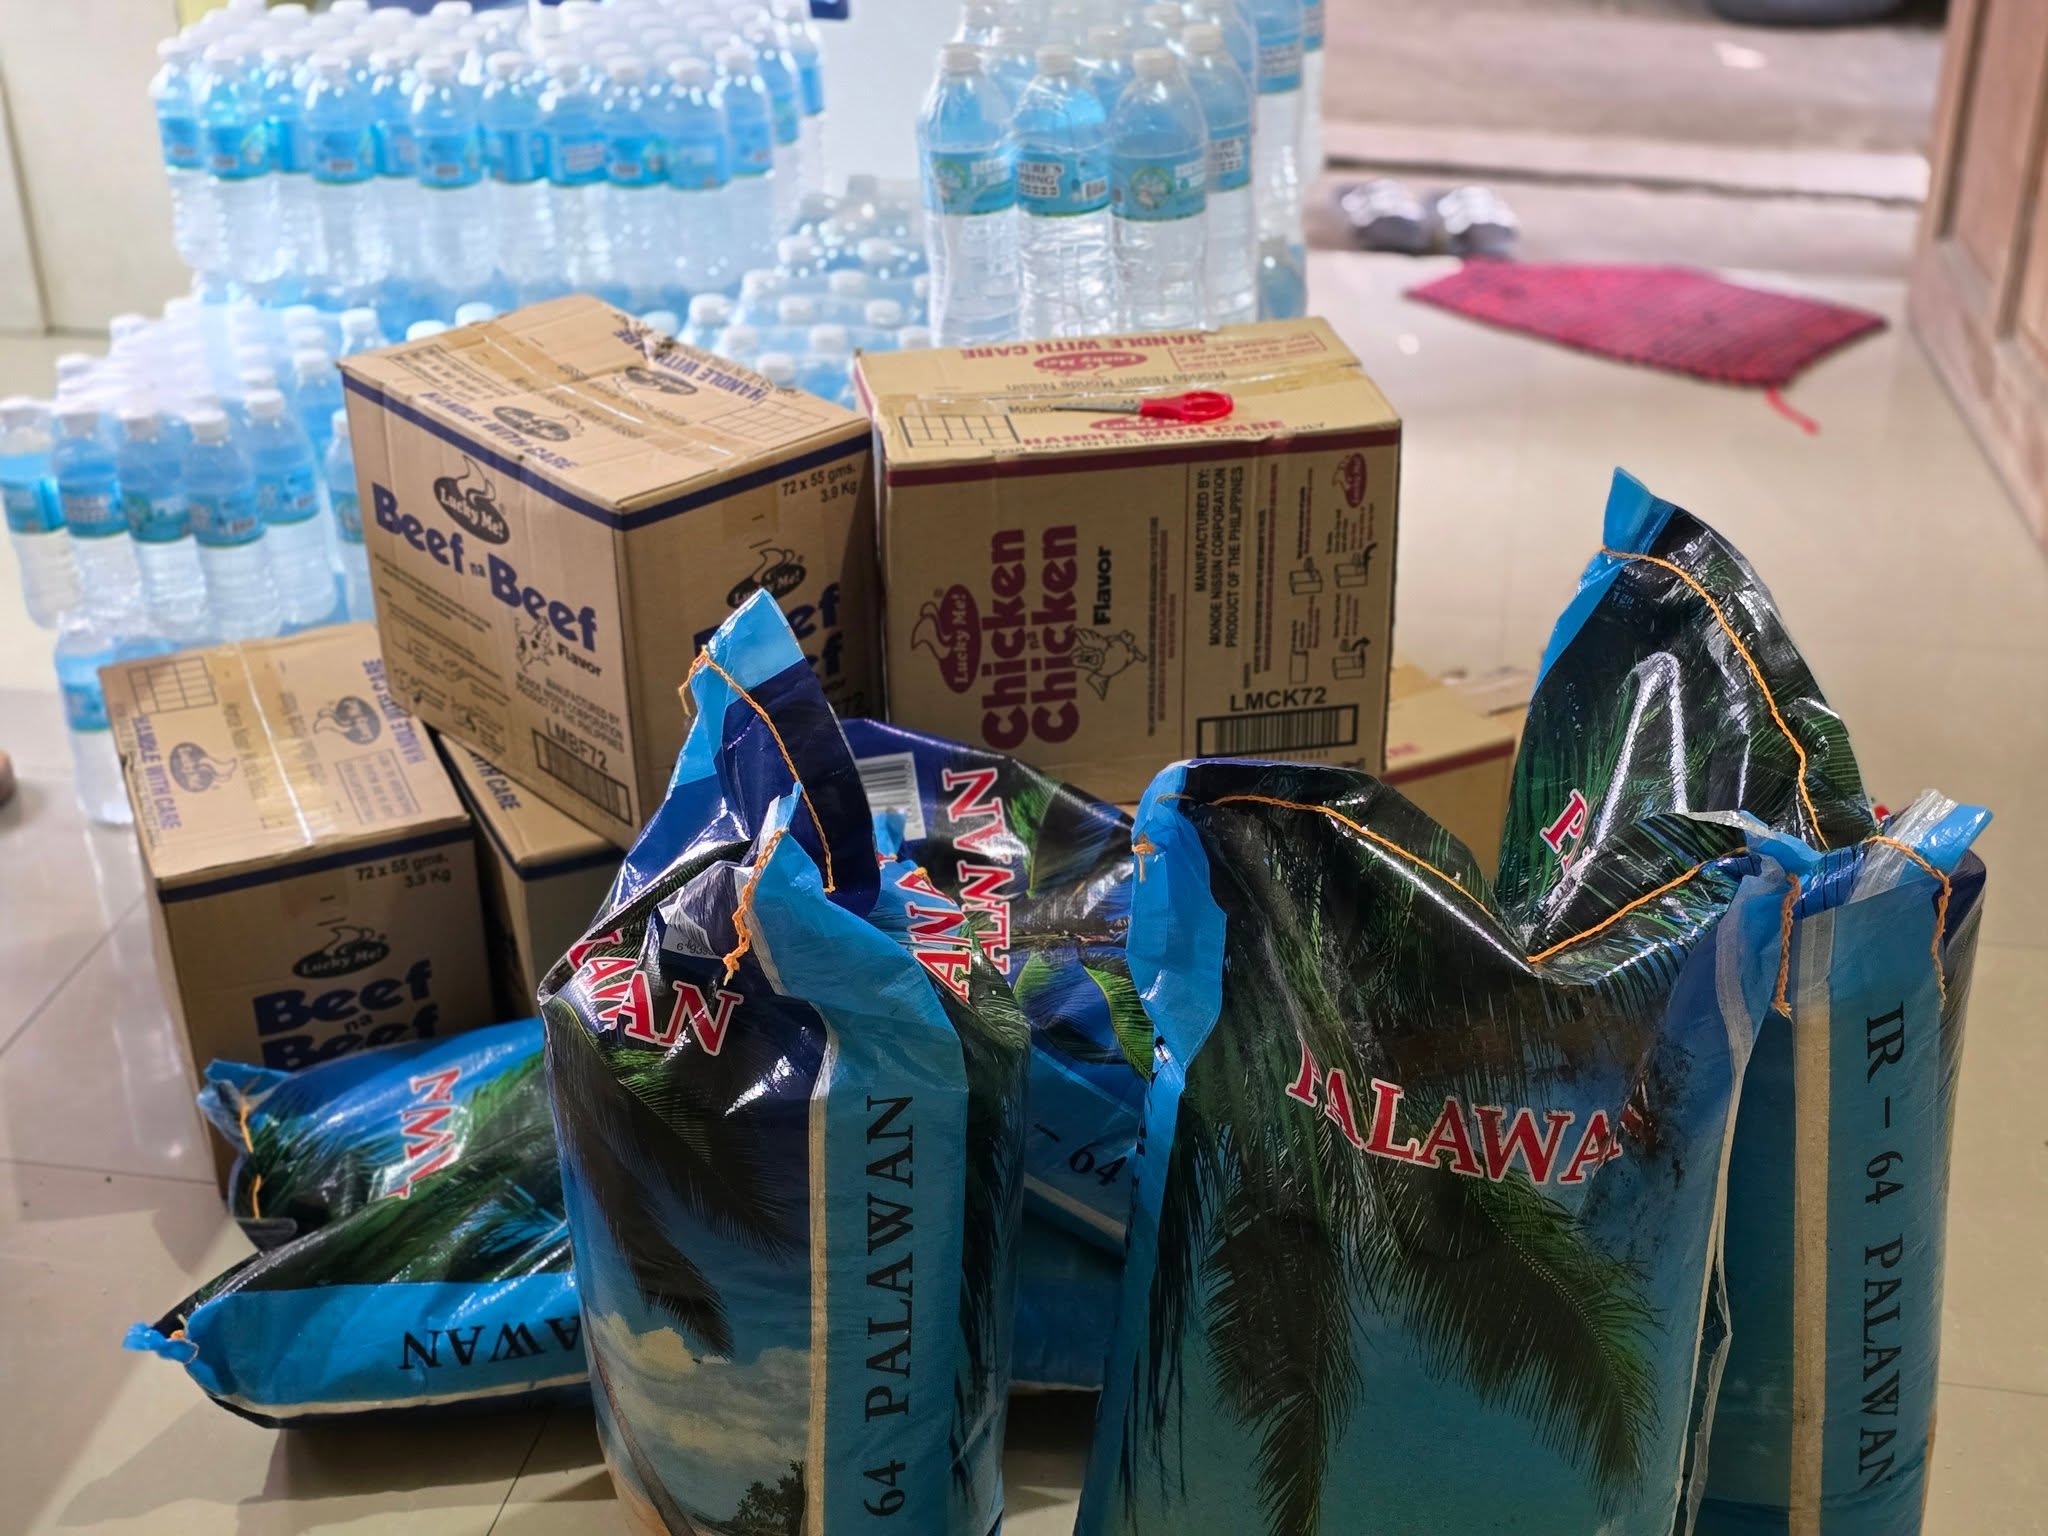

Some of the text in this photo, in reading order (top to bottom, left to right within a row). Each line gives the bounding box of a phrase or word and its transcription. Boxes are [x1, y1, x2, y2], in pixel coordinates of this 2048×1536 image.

[960, 334, 1206, 359] HANDLE WITH CARE
[696, 366, 769, 402] HANDLE
[1023, 420, 1285, 446] HANDLE WITH CARE
[781, 462, 856, 496] 72 x 55 gms.
[821, 480, 858, 502] 3.9 Kg
[438, 486, 504, 539] Lucky Me!
[1193, 490, 1209, 592] MANUFACTURED
[1208, 466, 1226, 647] MONDE NISSIN CORPORATION
[1225, 465, 1244, 648] PRODUCT OF THE PHILIPPINES
[372, 481, 464, 575] Beef
[469, 562, 487, 578] na
[487, 552, 597, 652] Beef
[1092, 545, 1113, 626] Flavor
[951, 593, 971, 684] Lucky Me!
[981, 528, 1030, 751] Chicken
[1030, 524, 1081, 745] Chicken
[1229, 686, 1328, 713] LMCK72
[144, 764, 172, 797] WITH
[486, 777, 523, 811] CARE
[154, 797, 183, 831] CARE
[354, 866, 375, 882] 72
[377, 864, 388, 877] x
[390, 858, 410, 875] 55
[404, 868, 453, 889] 3.9 Kg
[300, 947, 382, 976] Lucky Me!
[252, 959, 433, 1037] Beef
[343, 1013, 373, 1032] na
[1865, 1003, 1905, 1084] IR
[1068, 1140, 1129, 1187] 64
[1864, 1151, 1904, 1205] 64
[861, 1093, 916, 1518] 64 PALAWAN
[1857, 1236, 1905, 1492] PALAWAN
